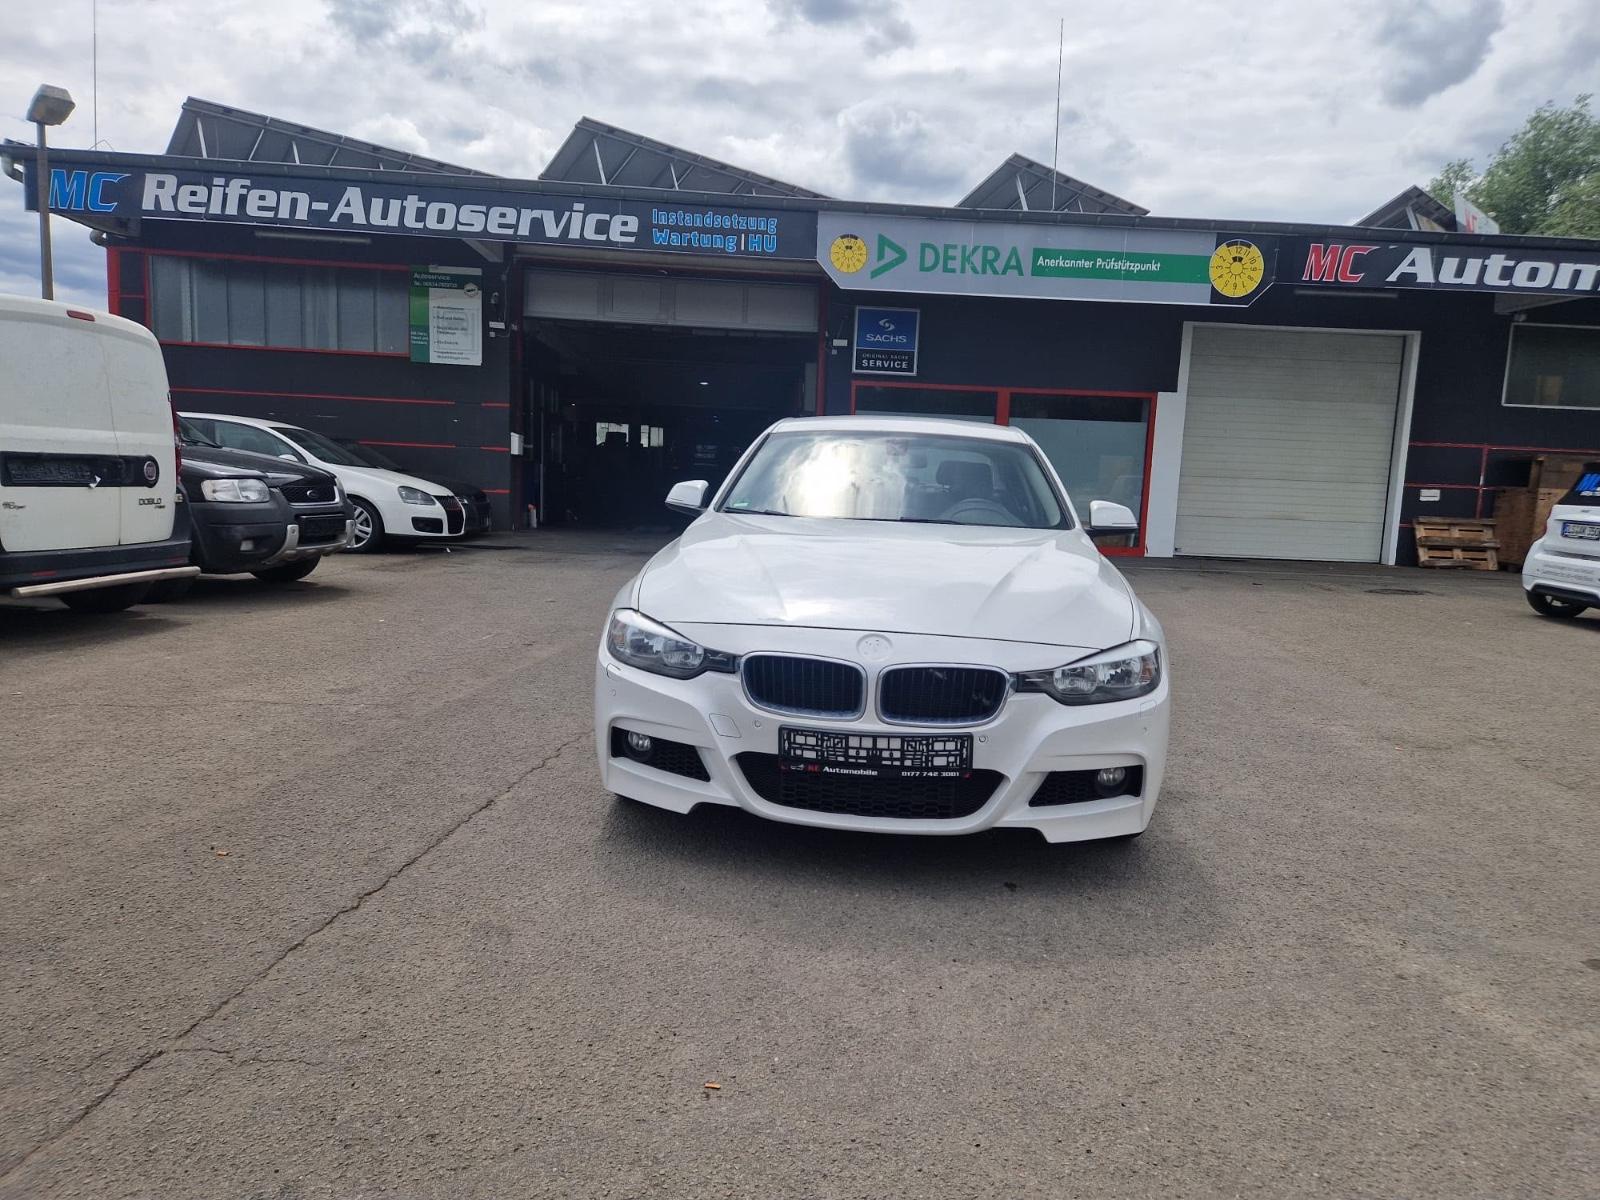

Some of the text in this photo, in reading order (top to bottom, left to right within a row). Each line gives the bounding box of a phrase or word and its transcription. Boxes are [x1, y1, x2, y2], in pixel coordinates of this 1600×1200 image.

[142, 172, 639, 243] Reifen-Autoservice
[652, 207, 779, 235] Instandsetzung
[652, 228, 737, 252] Wartung
[918, 242, 1024, 277] DEKRA
[1037, 255, 1161, 275] Anerkannter Prüfstützpunkt
[1301, 243, 1381, 283] MC
[865, 333, 907, 343] SACHS
[862, 359, 909, 369] SERVICE
[822, 766, 879, 776] Automobile
